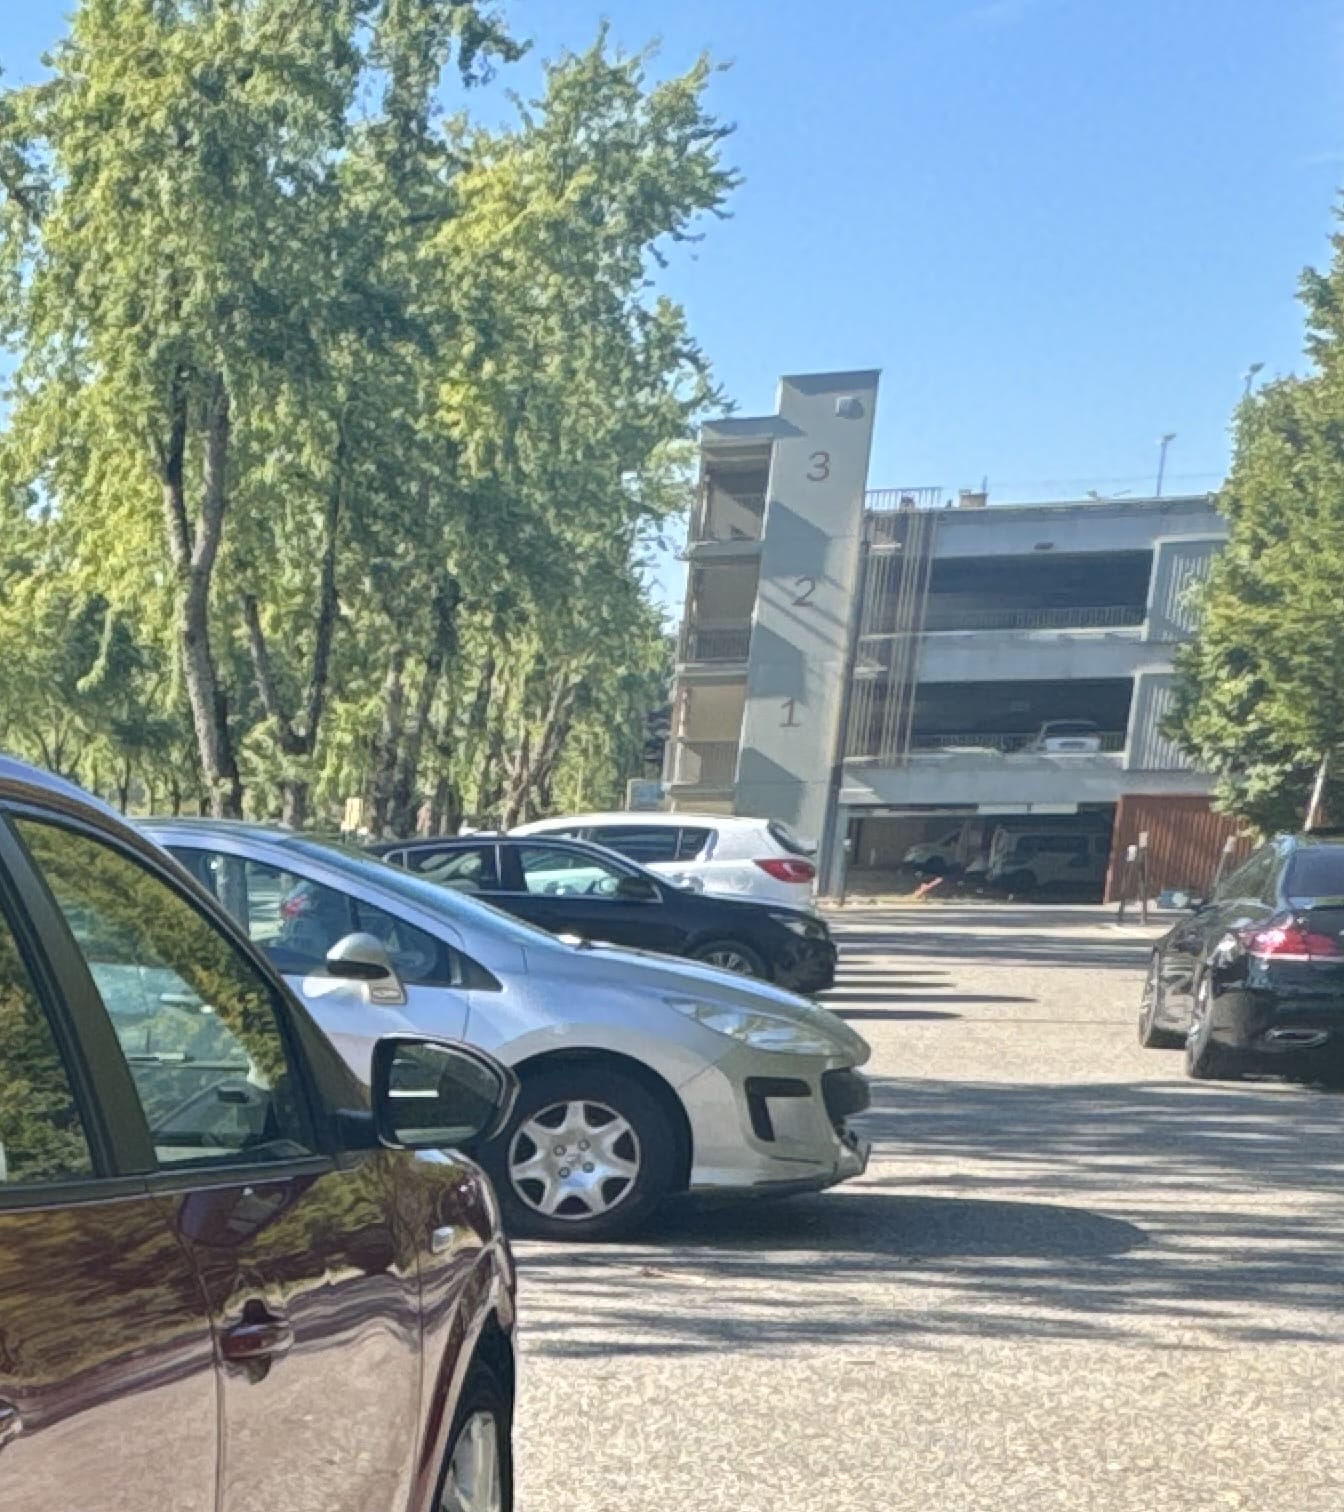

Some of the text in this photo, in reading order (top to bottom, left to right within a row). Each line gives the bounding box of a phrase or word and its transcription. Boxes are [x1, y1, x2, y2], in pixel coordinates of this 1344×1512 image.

[806, 451, 830, 481] 3
[792, 576, 816, 607] 2
[778, 698, 801, 728] 1
